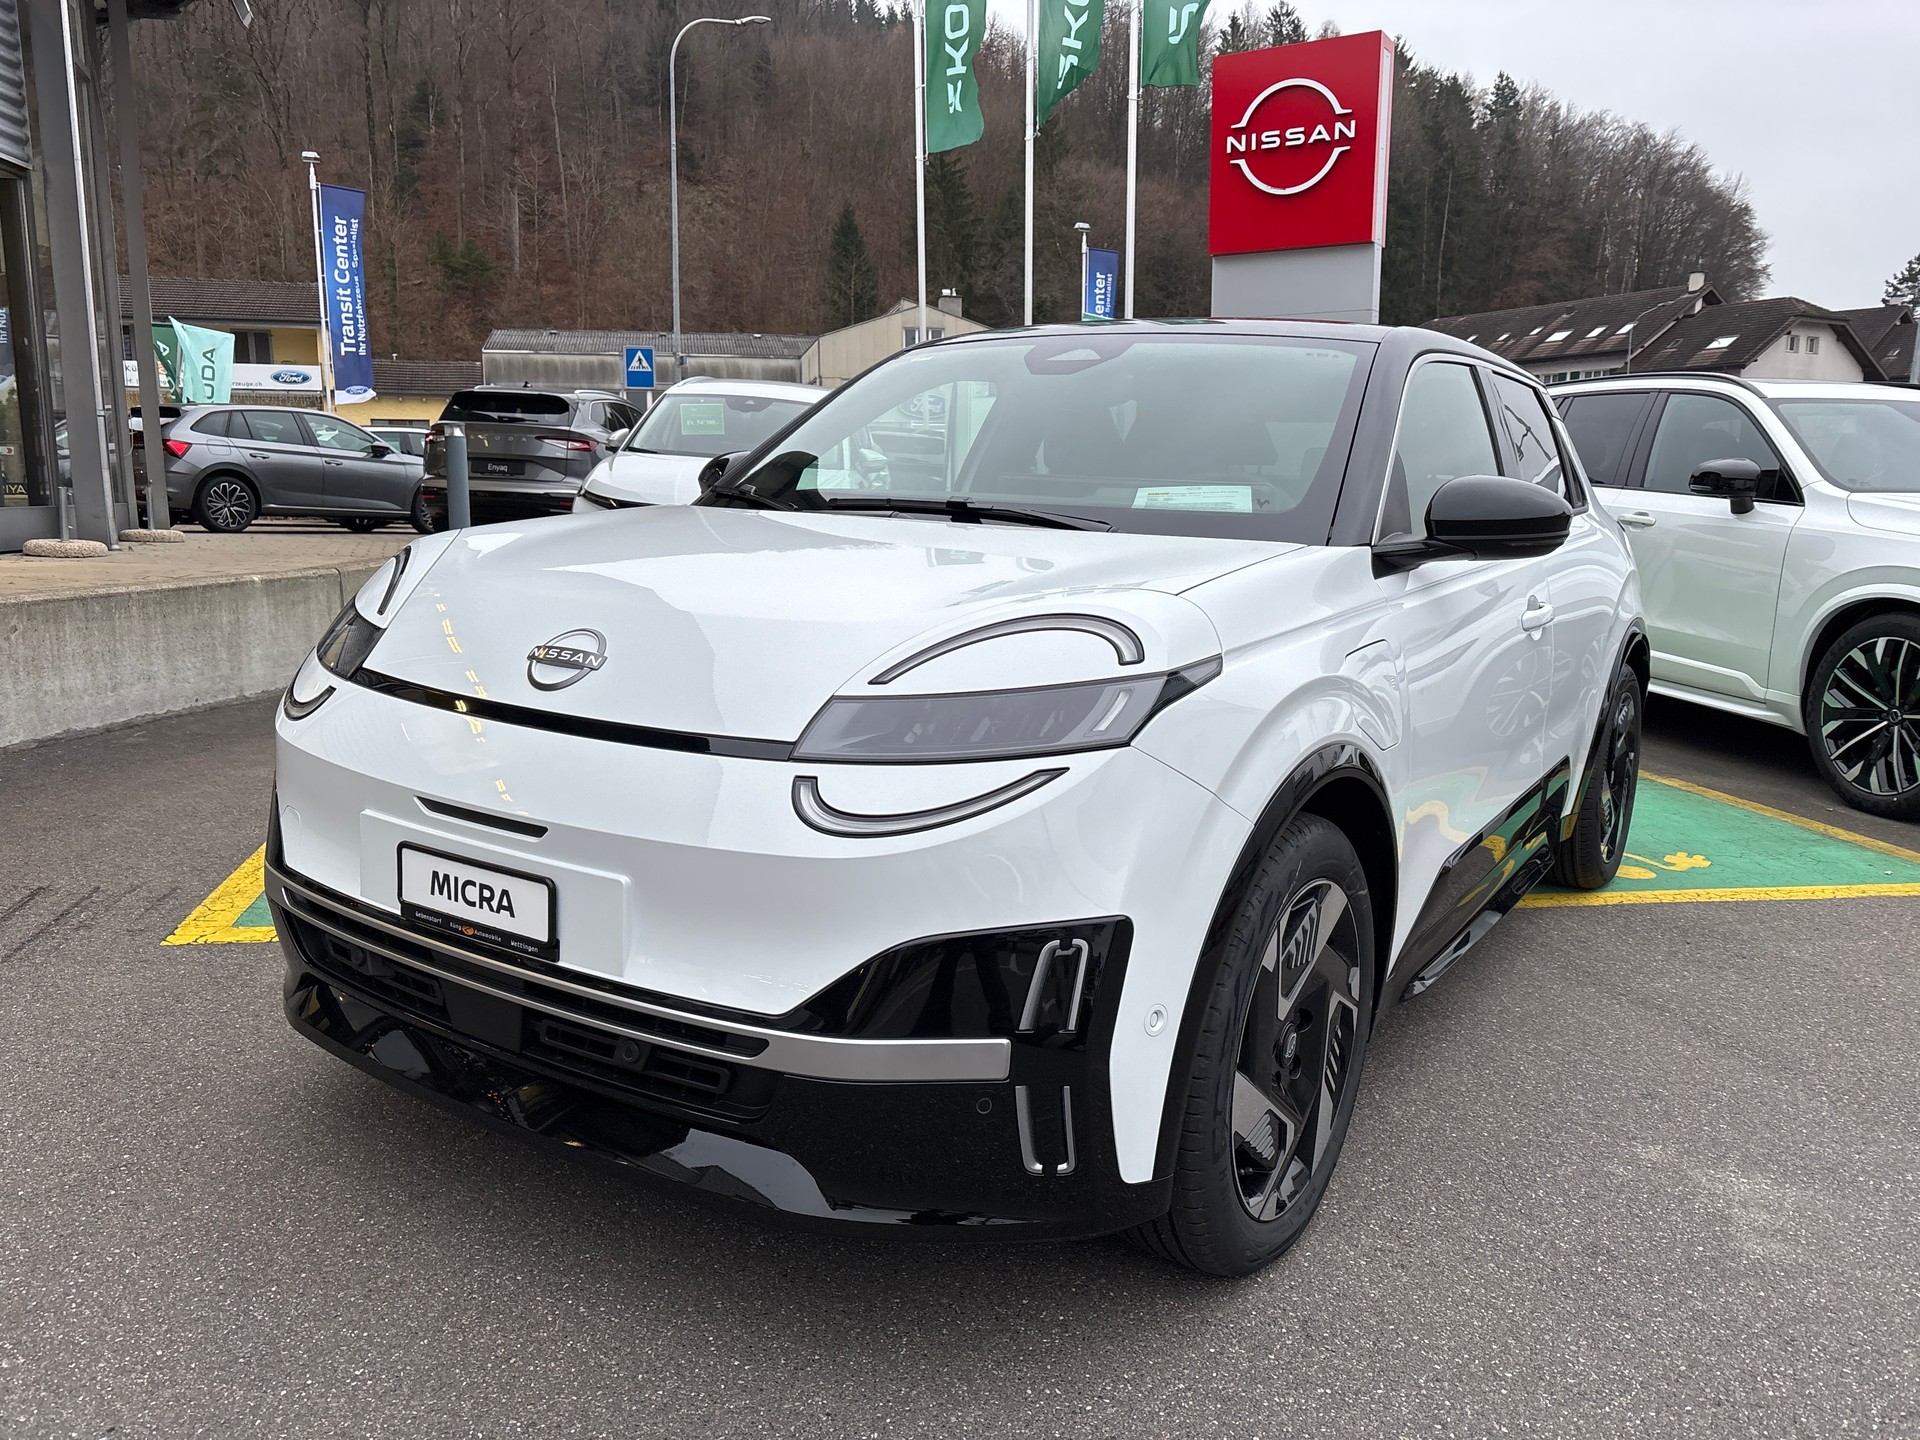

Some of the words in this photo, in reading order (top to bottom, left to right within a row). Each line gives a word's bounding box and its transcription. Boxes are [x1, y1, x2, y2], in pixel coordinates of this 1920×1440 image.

[1226, 119, 1356, 154] NISSAN
[334, 216, 351, 284] Center
[336, 288, 357, 356] Transit
[358, 341, 367, 356] Ihr
[487, 463, 508, 473] Enyaq
[529, 647, 602, 667] NISSAN
[430, 870, 516, 919] MICRA
[510, 939, 539, 953] Wettingen
